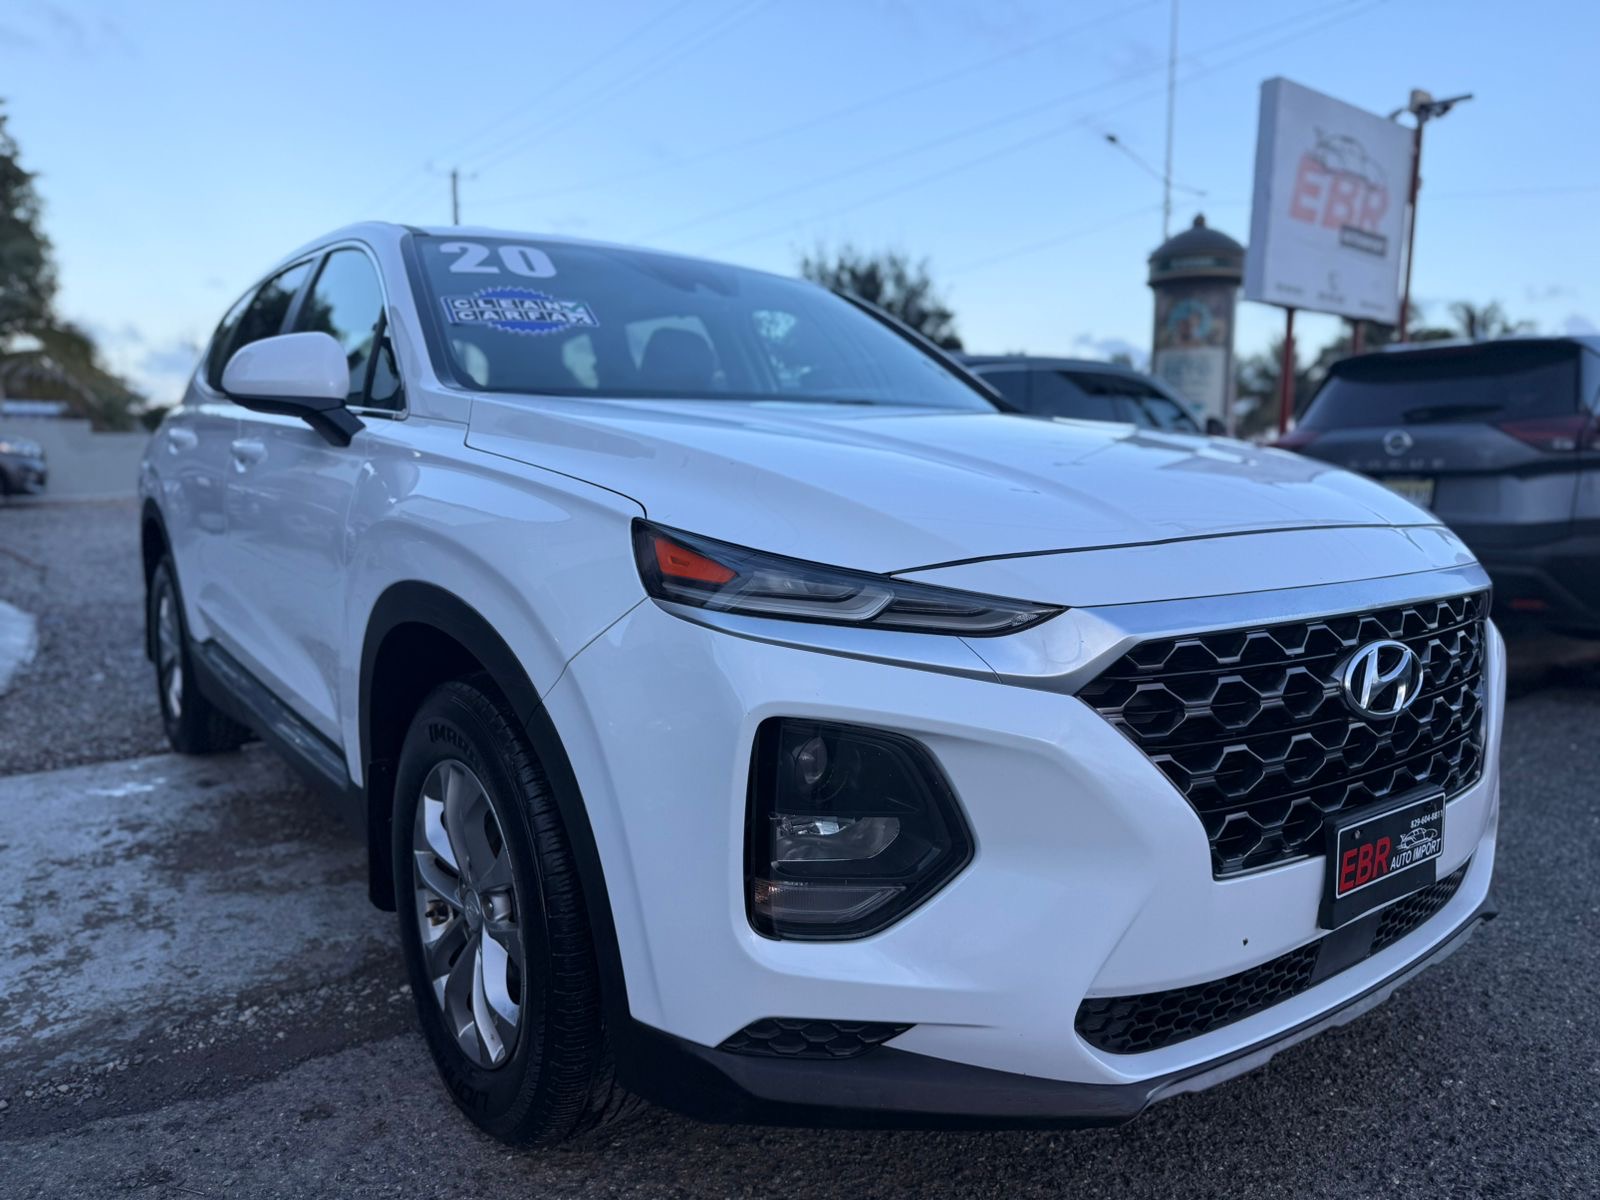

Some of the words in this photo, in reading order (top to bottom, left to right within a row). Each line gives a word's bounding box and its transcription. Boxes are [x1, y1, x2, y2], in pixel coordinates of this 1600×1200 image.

[1289, 153, 1391, 236] EBR
[440, 242, 557, 278] 20
[453, 299, 561, 311] CLEAN
[1340, 836, 1391, 892] EBR
[1390, 850, 1411, 871] AUTO
[1412, 838, 1441, 862] IMPORT
